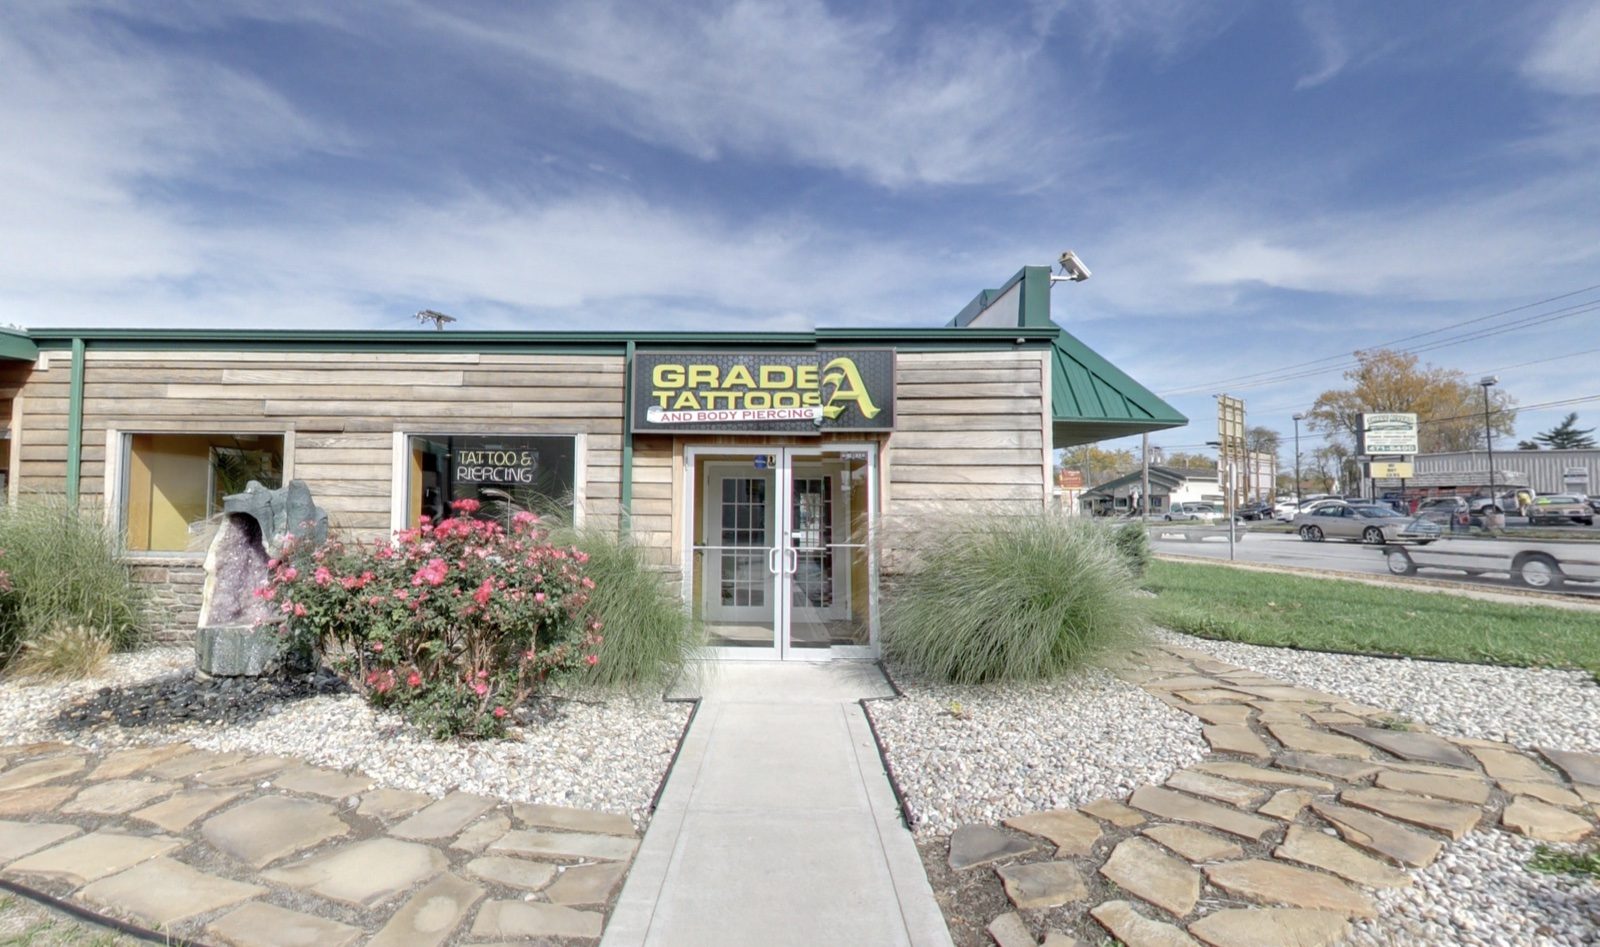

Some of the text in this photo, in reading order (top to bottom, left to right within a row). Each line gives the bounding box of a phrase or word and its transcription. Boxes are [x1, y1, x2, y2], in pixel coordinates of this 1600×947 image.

[653, 356, 881, 420] GRADE A
[653, 391, 822, 410] TATTOOS
[661, 409, 814, 422] AND BODY PIERCING
[459, 450, 532, 466] TATTOO &
[457, 466, 533, 483] PIERCING
